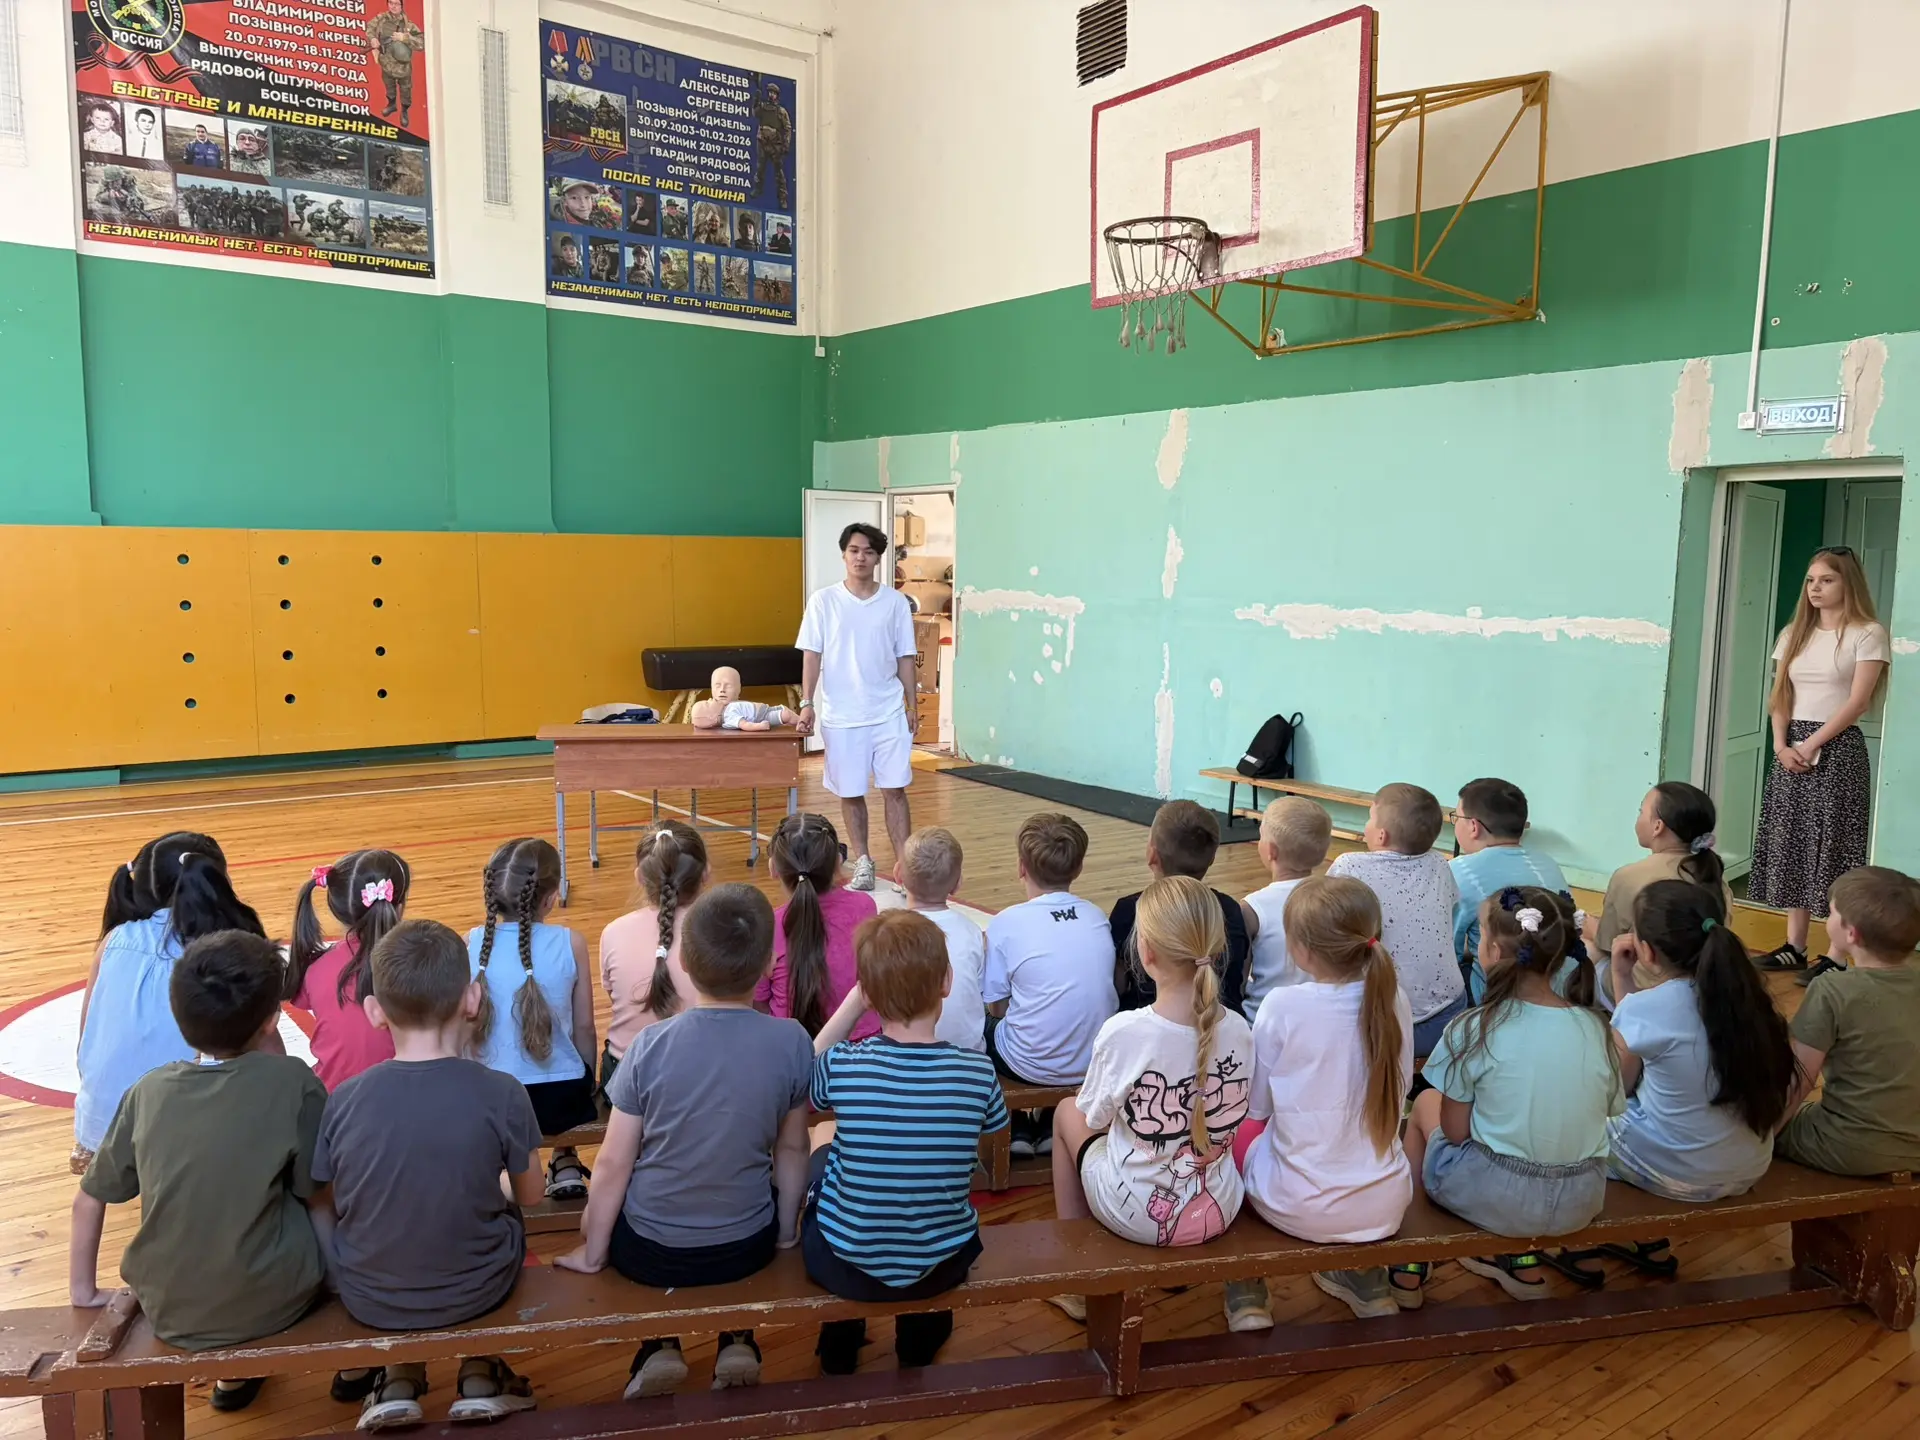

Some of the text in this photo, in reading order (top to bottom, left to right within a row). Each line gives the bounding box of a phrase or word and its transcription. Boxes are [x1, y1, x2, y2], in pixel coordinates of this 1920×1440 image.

[229, 12, 367, 47] ПОЗЫВНОЙ «КРЕН»
[233, 0, 366, 31] ВЛАДИМИРОВИЧ
[112, 30, 162, 50] РОССИЯ
[224, 30, 367, 65] 20.07.1979-18.11.2023
[199, 41, 367, 83] ВЫПУСКНИК 1994 ГОДА
[590, 38, 675, 84] РВСН
[191, 59, 369, 101] РЯДОВОЙ (ШТУРМОВИК)
[679, 78, 750, 102] АЛЕКСАНДР
[700, 68, 749, 88] ЛЕБЕДЕВ
[112, 81, 398, 139] БЫСТРЫЕ И МАНЕВРЕННЫЕ
[260, 88, 370, 116] БОЕЦ-СТРЕЛОК
[636, 99, 751, 132] ПОЗЫВНОЙ «ДИЗЕЛЬ»
[687, 95, 749, 117] СЕРГЕЕВИЧ
[590, 126, 620, 142] РВСН
[629, 127, 697, 150] ВЫПУСКНИК
[699, 141, 721, 154] 2019
[723, 147, 750, 160] ГОДА
[637, 115, 751, 146] 30.09.2003-01.02.2026
[650, 146, 750, 174] ГВАРДИИ РЯДОВОЙ
[667, 164, 751, 188] ОПЕРАТОР БПЛА
[602, 168, 746, 203] ПОСЛЕ НАС ТИШИНА
[88, 222, 431, 272] НЕЗАМЕНИМЫХ НЕТ. ЕСТЬ НЕПОВТОРИМЫЕ.
[551, 280, 793, 319] НЕЗАМЕНИМЫХ НЕТ. ЕСТЬ НЕПОВТОРИМЫЕ.
[1770, 406, 1830, 423] ВЫХОД
